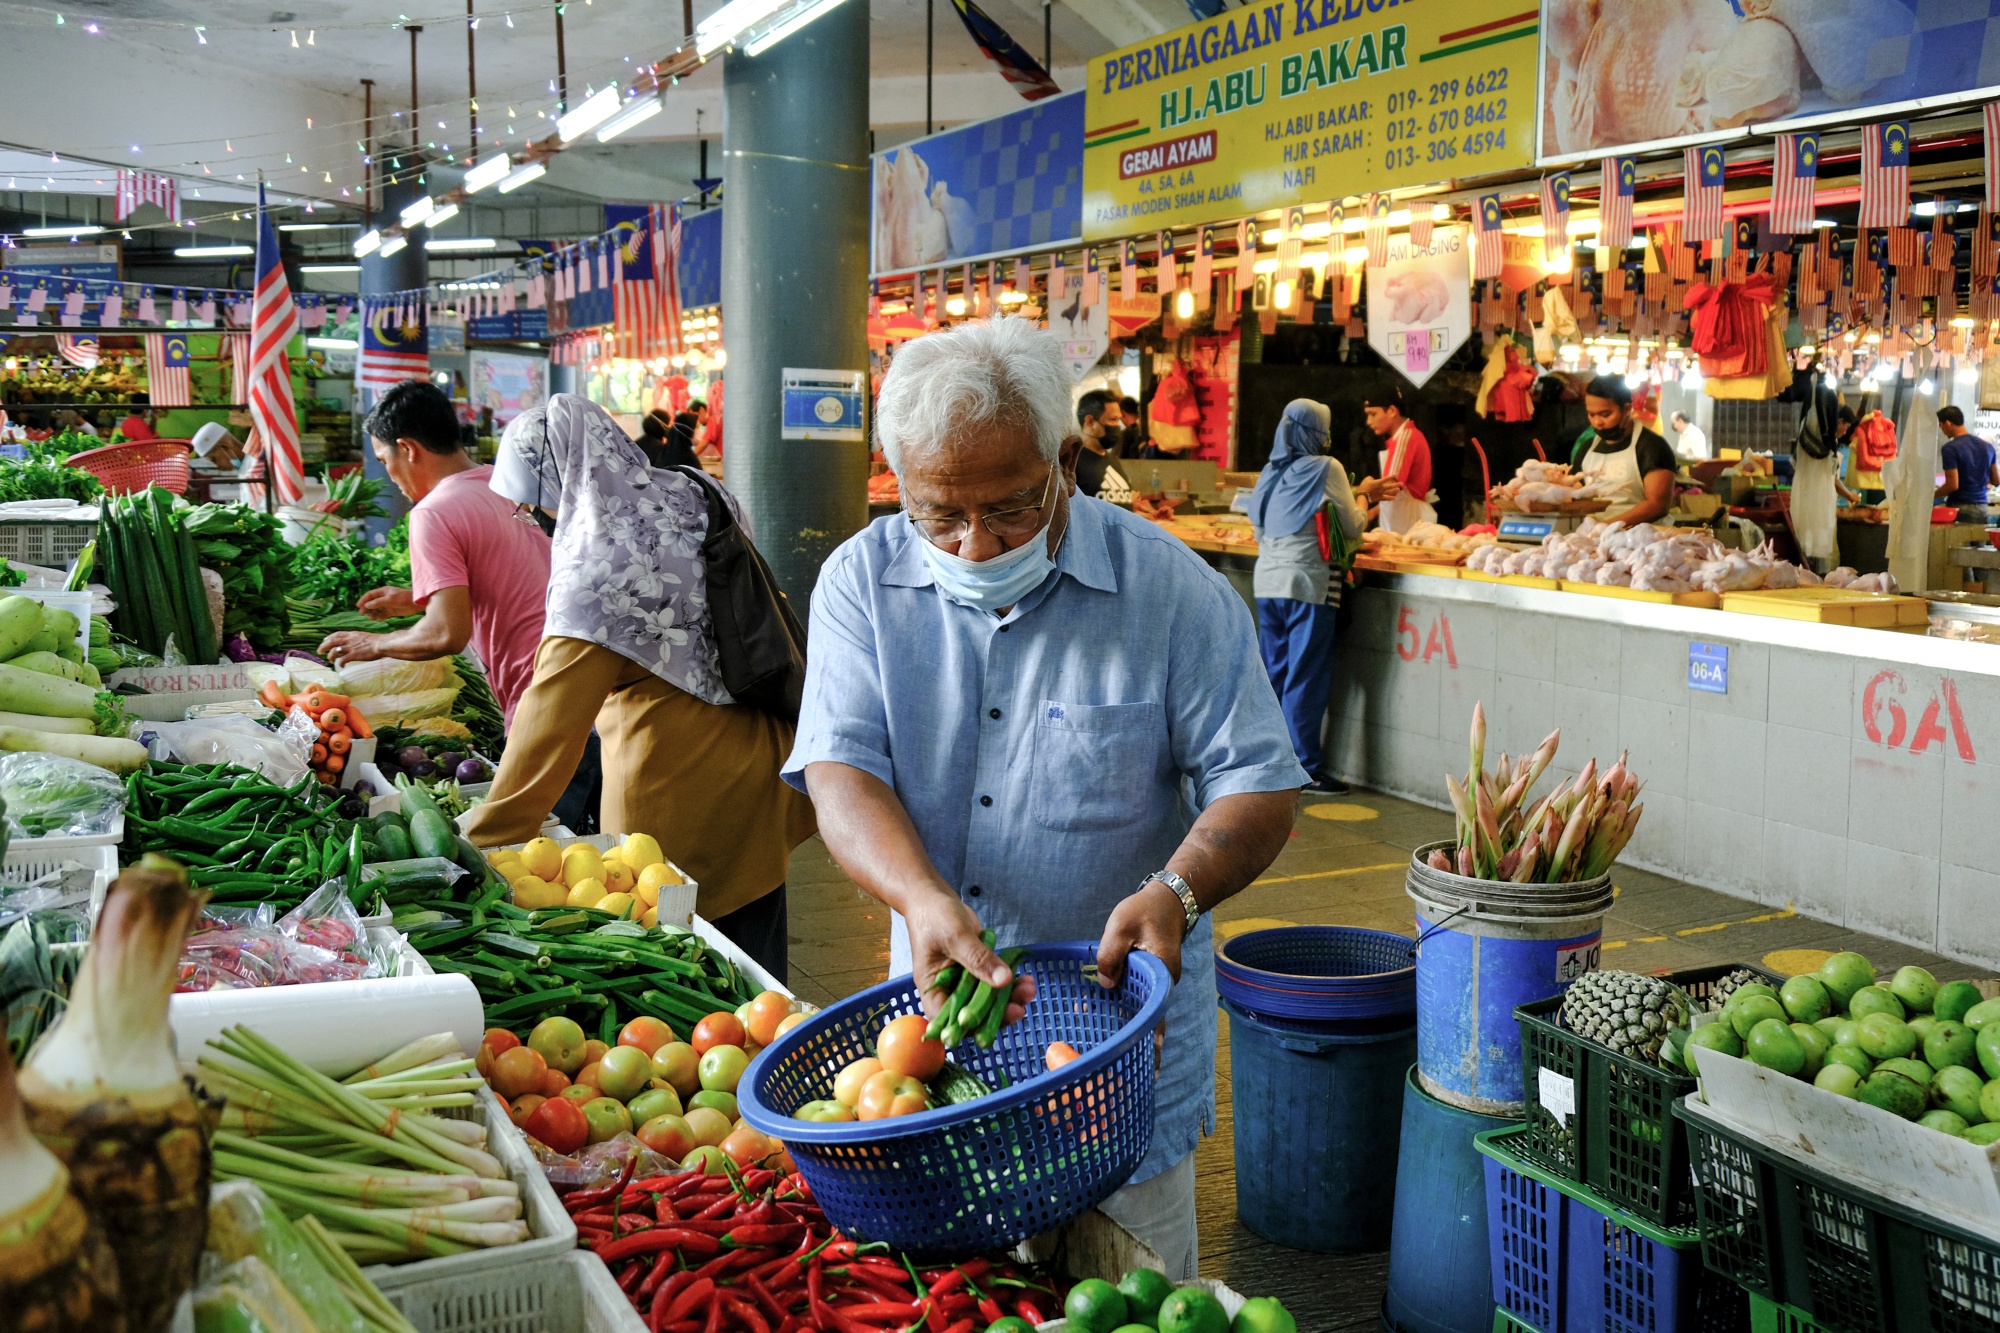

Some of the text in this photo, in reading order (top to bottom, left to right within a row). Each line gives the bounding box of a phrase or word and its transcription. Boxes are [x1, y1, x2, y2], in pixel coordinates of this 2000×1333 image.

[1103, 3, 1284, 94] PERNIAGAAN
[1160, 23, 1408, 130] HJ.ABU BAKAR
[1265, 113, 1313, 141] HJ.ABU
[1388, 89, 1423, 114] 019-
[1429, 79, 1459, 105] 299
[1465, 67, 1508, 97] 6622
[1284, 141, 1308, 163] HJR
[1313, 129, 1363, 157] SARAH
[1387, 117, 1422, 142] 012-
[1428, 108, 1458, 134] 670
[1464, 98, 1507, 127] 8462
[1122, 134, 1212, 175] GERAI AYAM
[1179, 170, 1194, 186] 6A
[1283, 166, 1315, 189] NAFI
[1386, 146, 1421, 170] 013-
[1427, 136, 1457, 162] 306
[1463, 128, 1506, 155] 4594
[1096, 182, 1242, 223] PASAR MODEN SHAH ALAM
[1411, 235, 1460, 259] DAGING
[1397, 604, 1458, 669] 5A
[1692, 661, 1722, 682] 06-A
[1863, 668, 1976, 765] 6A
[1583, 945, 1600, 974] JO
